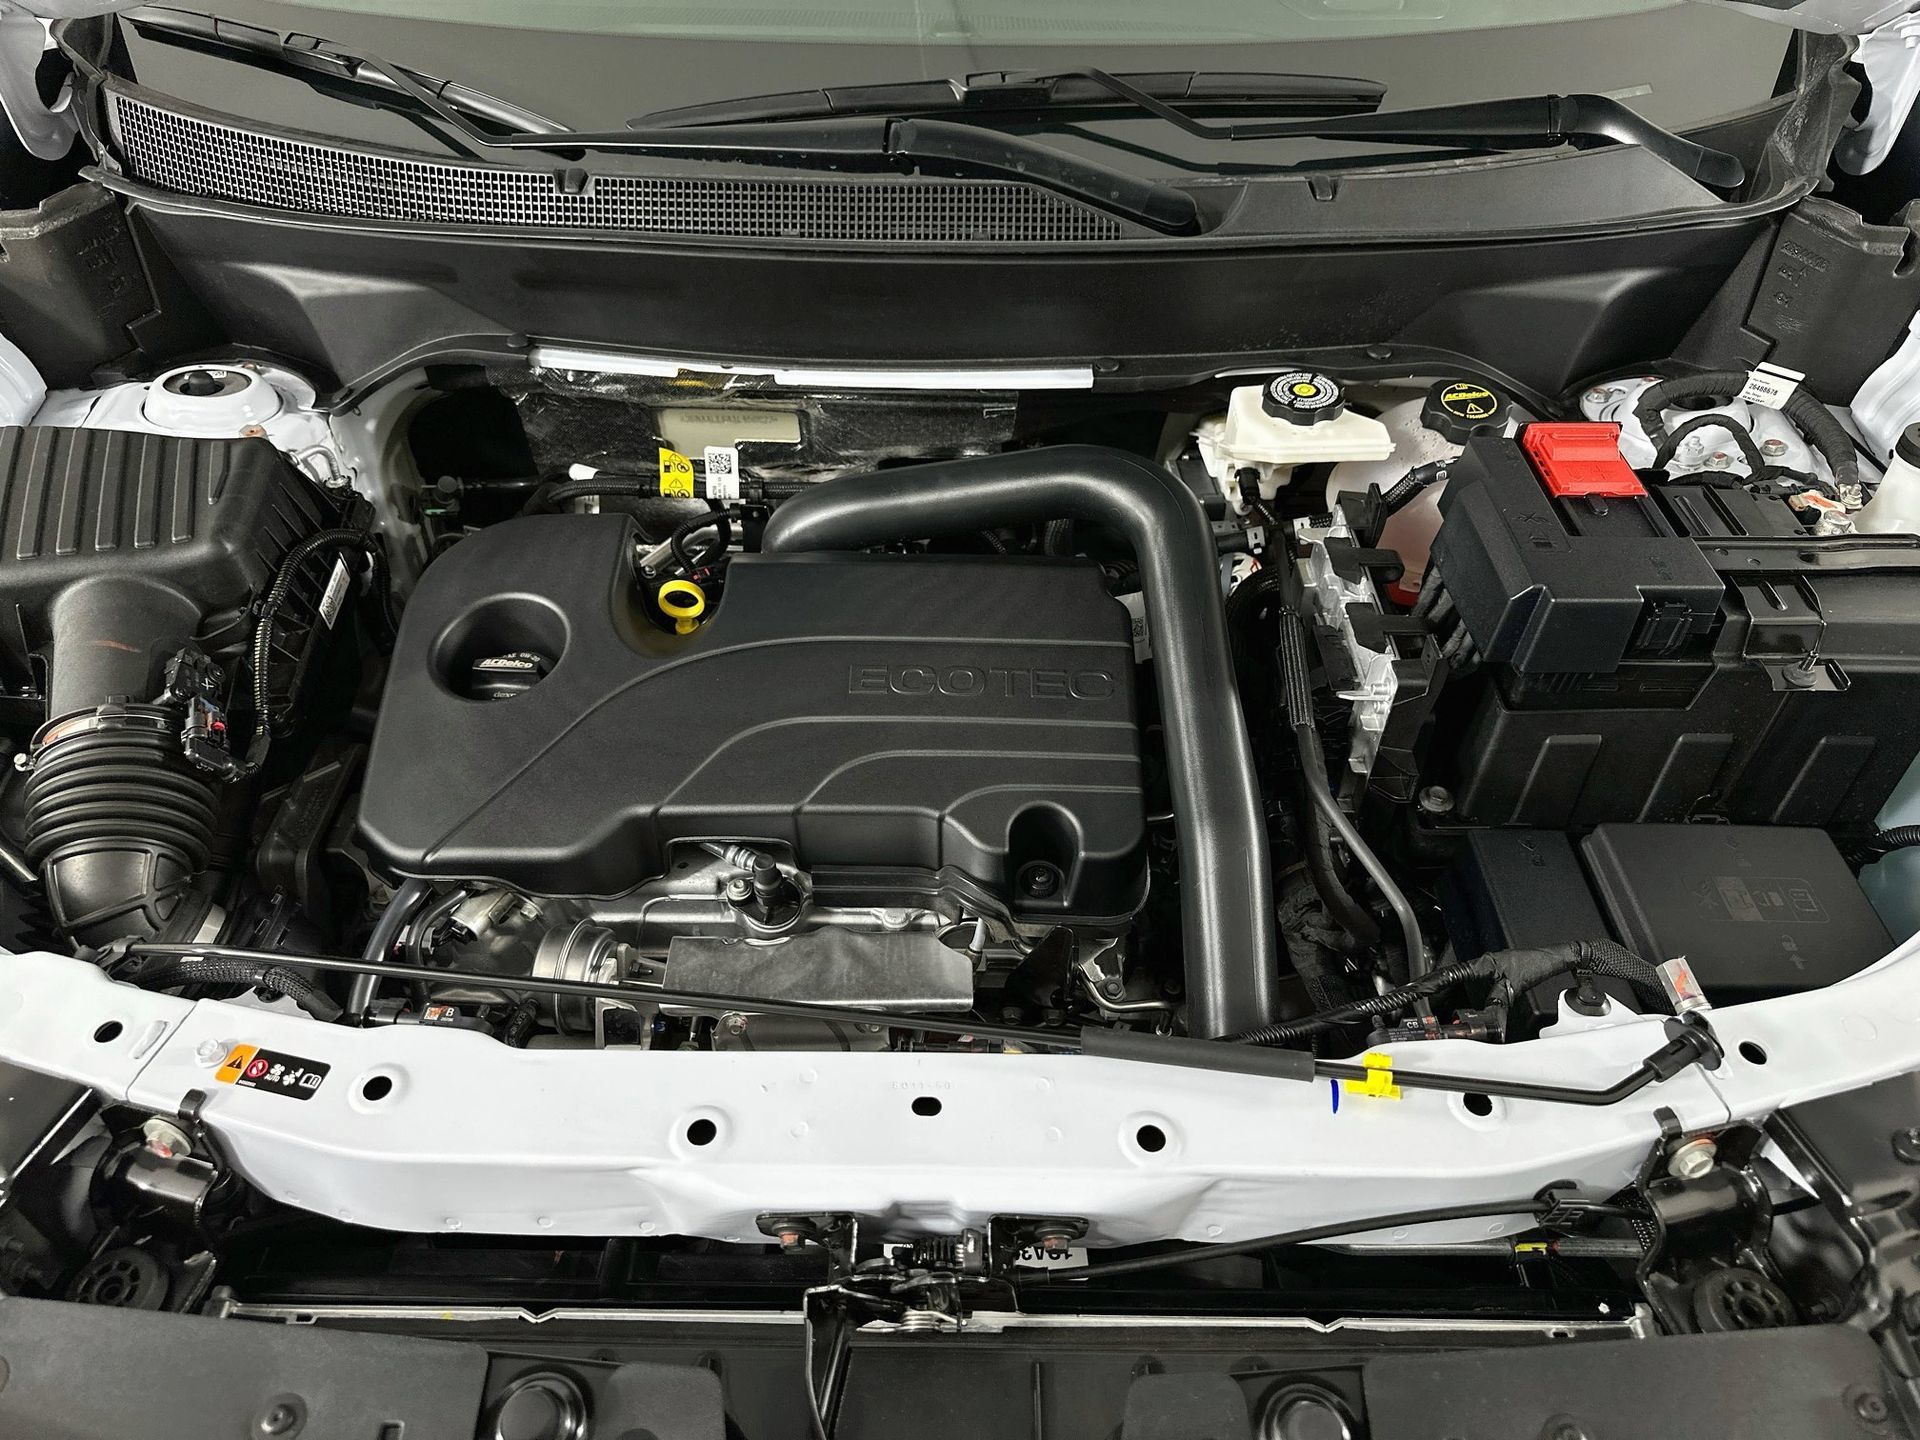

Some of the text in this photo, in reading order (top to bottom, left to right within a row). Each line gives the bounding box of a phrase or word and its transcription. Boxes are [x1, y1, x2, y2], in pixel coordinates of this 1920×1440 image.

[1444, 390, 1489, 401] ACDelco
[480, 659, 533, 668] ACDelco
[849, 664, 1114, 700] ECOTEC
[445, 1007, 455, 1017] B
[1406, 1021, 1419, 1029] CB
[264, 1073, 281, 1083] AUTO
